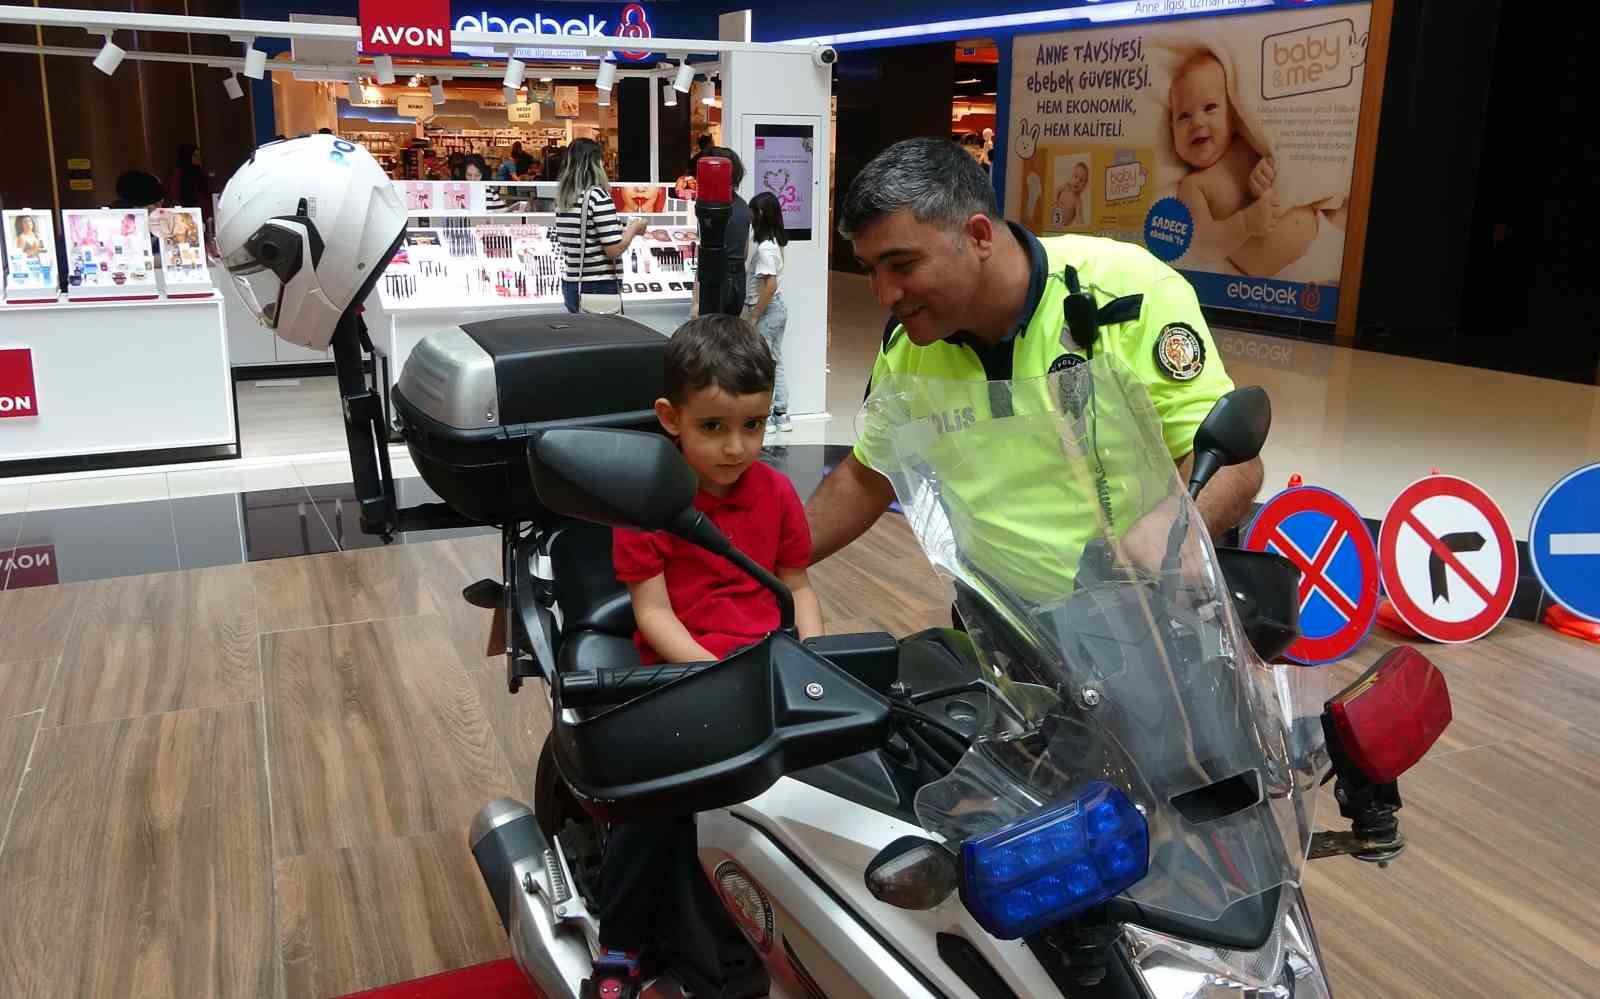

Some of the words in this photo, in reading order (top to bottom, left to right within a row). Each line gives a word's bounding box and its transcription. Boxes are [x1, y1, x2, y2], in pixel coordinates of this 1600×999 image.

[1134, 1, 1160, 15] Anne
[370, 26, 444, 47] AVON
[1036, 43, 1069, 66] ANNE
[1073, 36, 1145, 64] TAVSİYESİ,
[1273, 36, 1341, 70] baby
[1026, 68, 1074, 94] ebebek
[1079, 65, 1152, 91] GÜVENCESİ.
[1036, 100, 1062, 115] HEM
[1066, 96, 1137, 115] EKONOMİK,
[1043, 122, 1070, 137] HEM
[1073, 119, 1125, 137] KALİTELİ.
[1151, 215, 1189, 236] SADECE
[1227, 281, 1297, 305] ebebek
